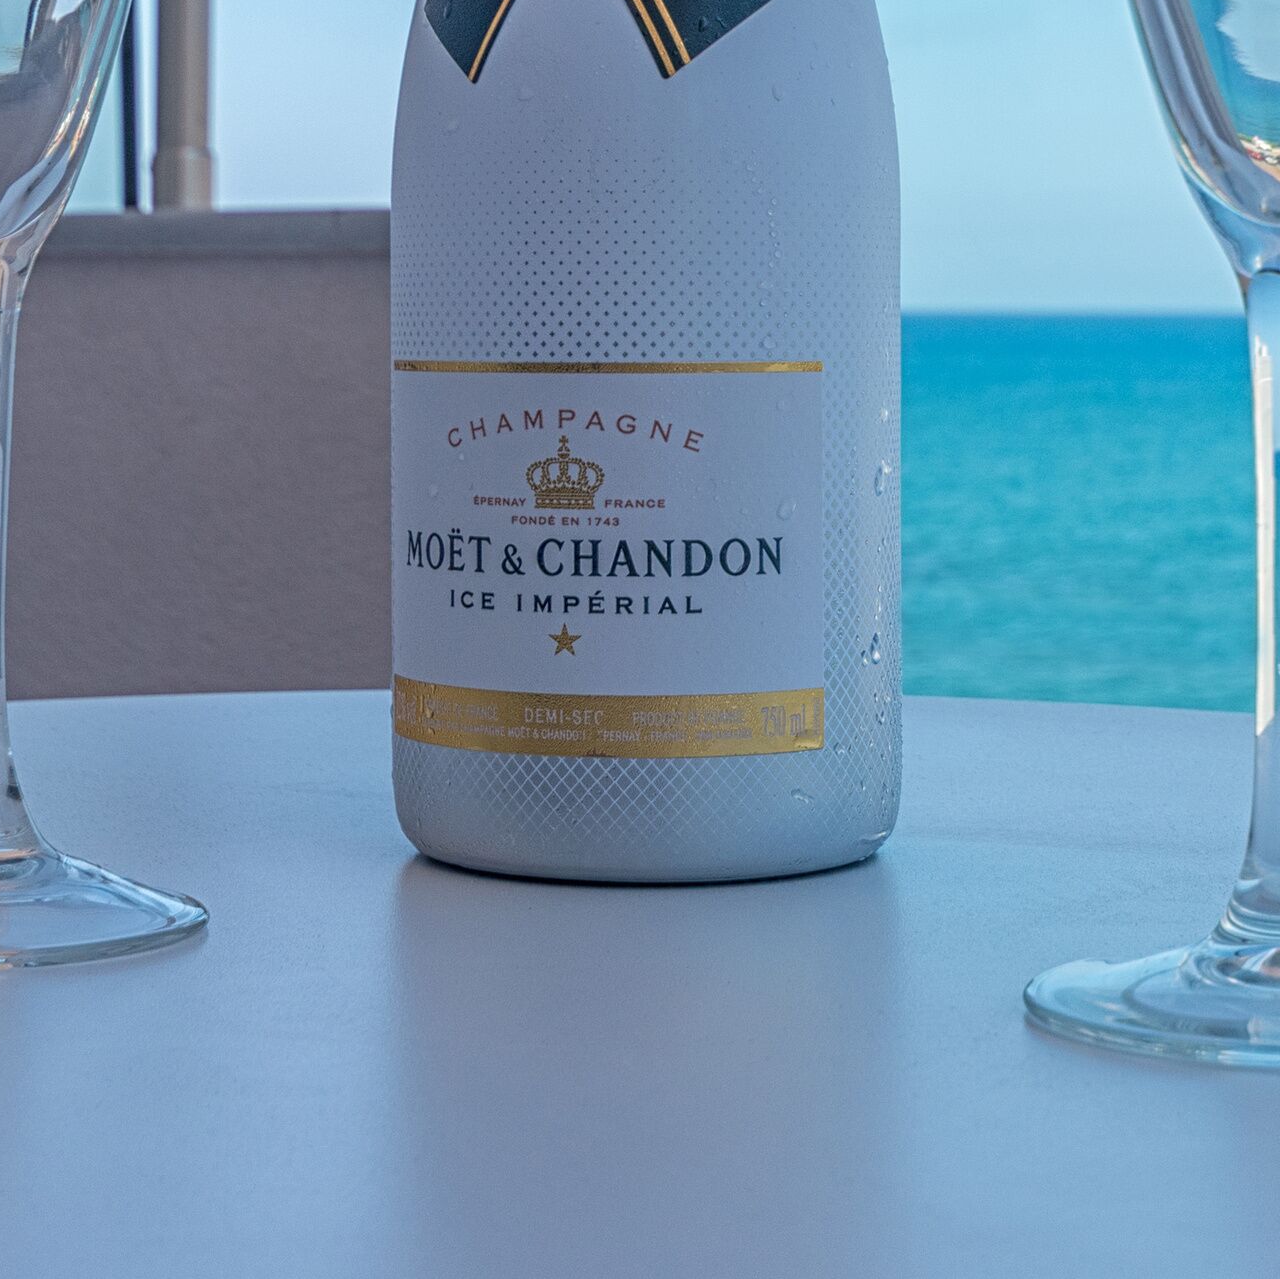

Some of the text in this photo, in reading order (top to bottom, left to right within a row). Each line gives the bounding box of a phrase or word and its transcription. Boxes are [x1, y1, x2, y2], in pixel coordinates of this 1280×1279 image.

[447, 408, 704, 453] CHAMPAGNE
[473, 494, 666, 509] ÉPERNAY FRANCE
[511, 513, 621, 527] FONDÉ EN 1743
[406, 528, 784, 578] MOËT & CHANDON
[450, 588, 703, 615] ICE IMPÉRIAL
[525, 707, 603, 725] DEMI-SEC
